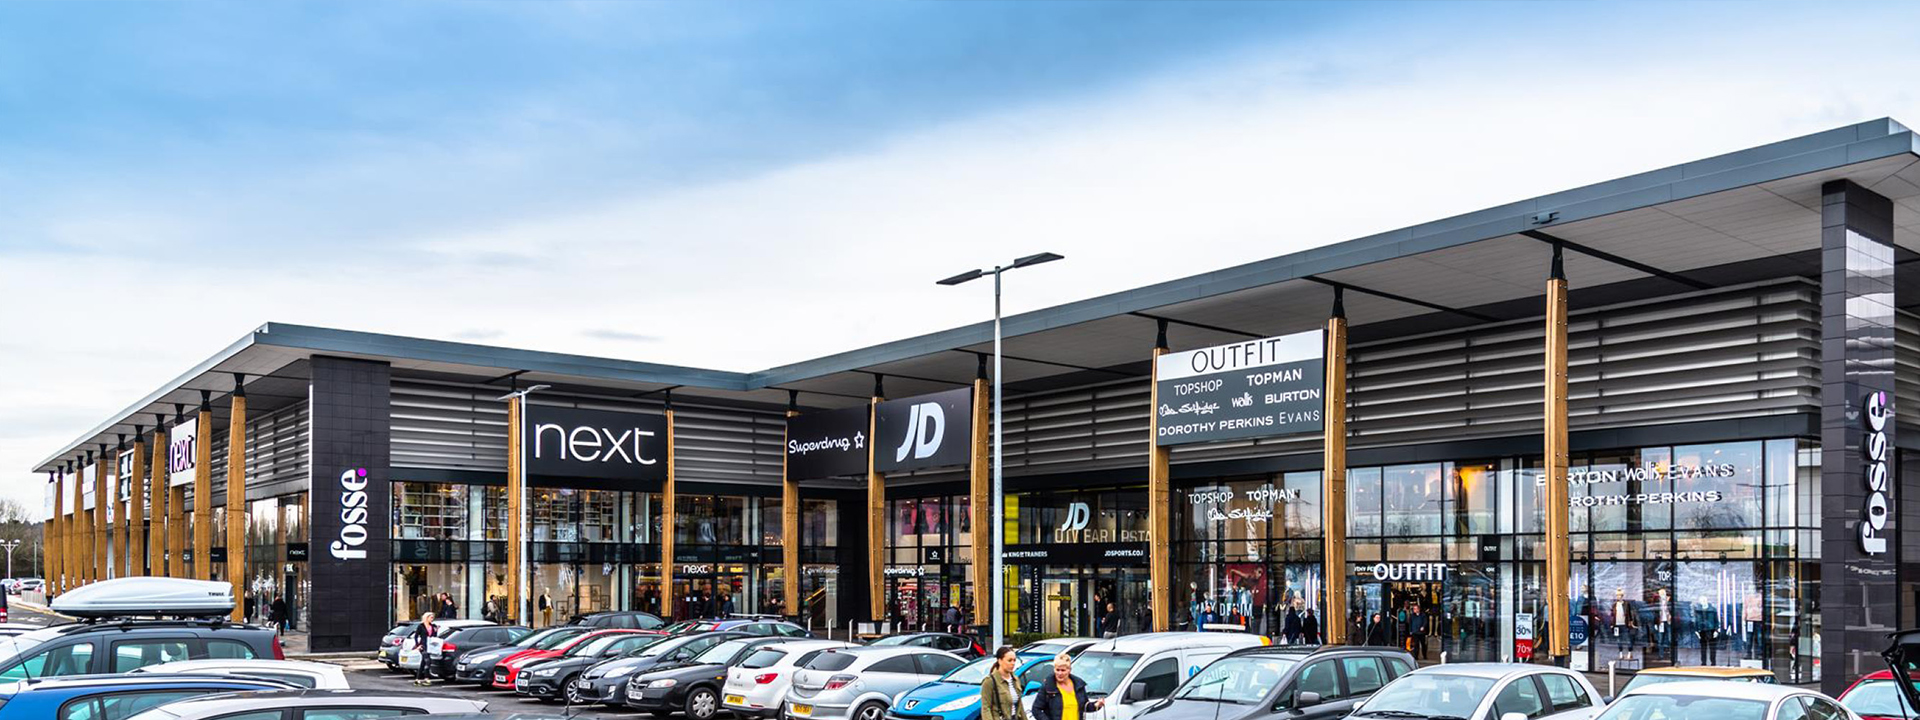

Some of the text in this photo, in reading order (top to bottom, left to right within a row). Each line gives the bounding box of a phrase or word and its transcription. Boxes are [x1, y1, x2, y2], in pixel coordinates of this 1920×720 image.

[1191, 338, 1281, 373] OUTFIT
[1174, 368, 1302, 396] TOPSHOP TOPMAN
[1264, 388, 1320, 405] BURTON
[896, 402, 946, 463] JD
[1158, 422, 1216, 437] DOROTHY
[1219, 415, 1274, 430] PERKINS
[535, 423, 657, 465] next
[788, 436, 851, 456] Superdrug
[1535, 469, 1617, 487] BRTON
[1188, 488, 1295, 504] TOPSHOP TOPMAN
[1568, 490, 1719, 507] ROTHY PERKINS
[1061, 502, 1091, 532] JD
[682, 564, 709, 574] next
[884, 566, 917, 579] perdrug
[1373, 563, 1447, 581] OUTFIT
[1658, 570, 1672, 581] TOP
